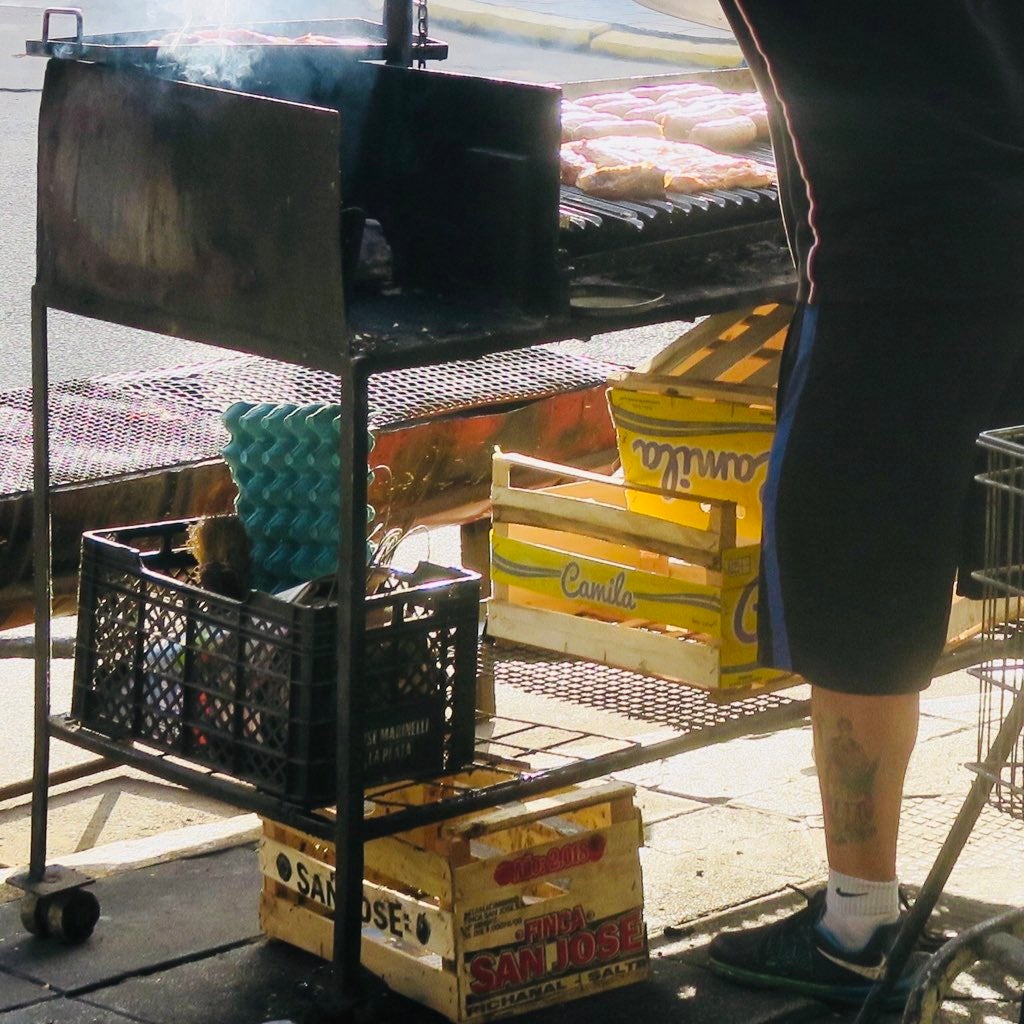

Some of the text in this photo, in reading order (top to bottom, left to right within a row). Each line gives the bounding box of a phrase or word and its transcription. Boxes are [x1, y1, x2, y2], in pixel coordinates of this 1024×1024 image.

[560, 561, 637, 610] Camila
[360, 895, 404, 938] OSE
[524, 904, 587, 943] FINCA
[469, 945, 548, 995] SAN
[551, 908, 645, 972] JOSE
